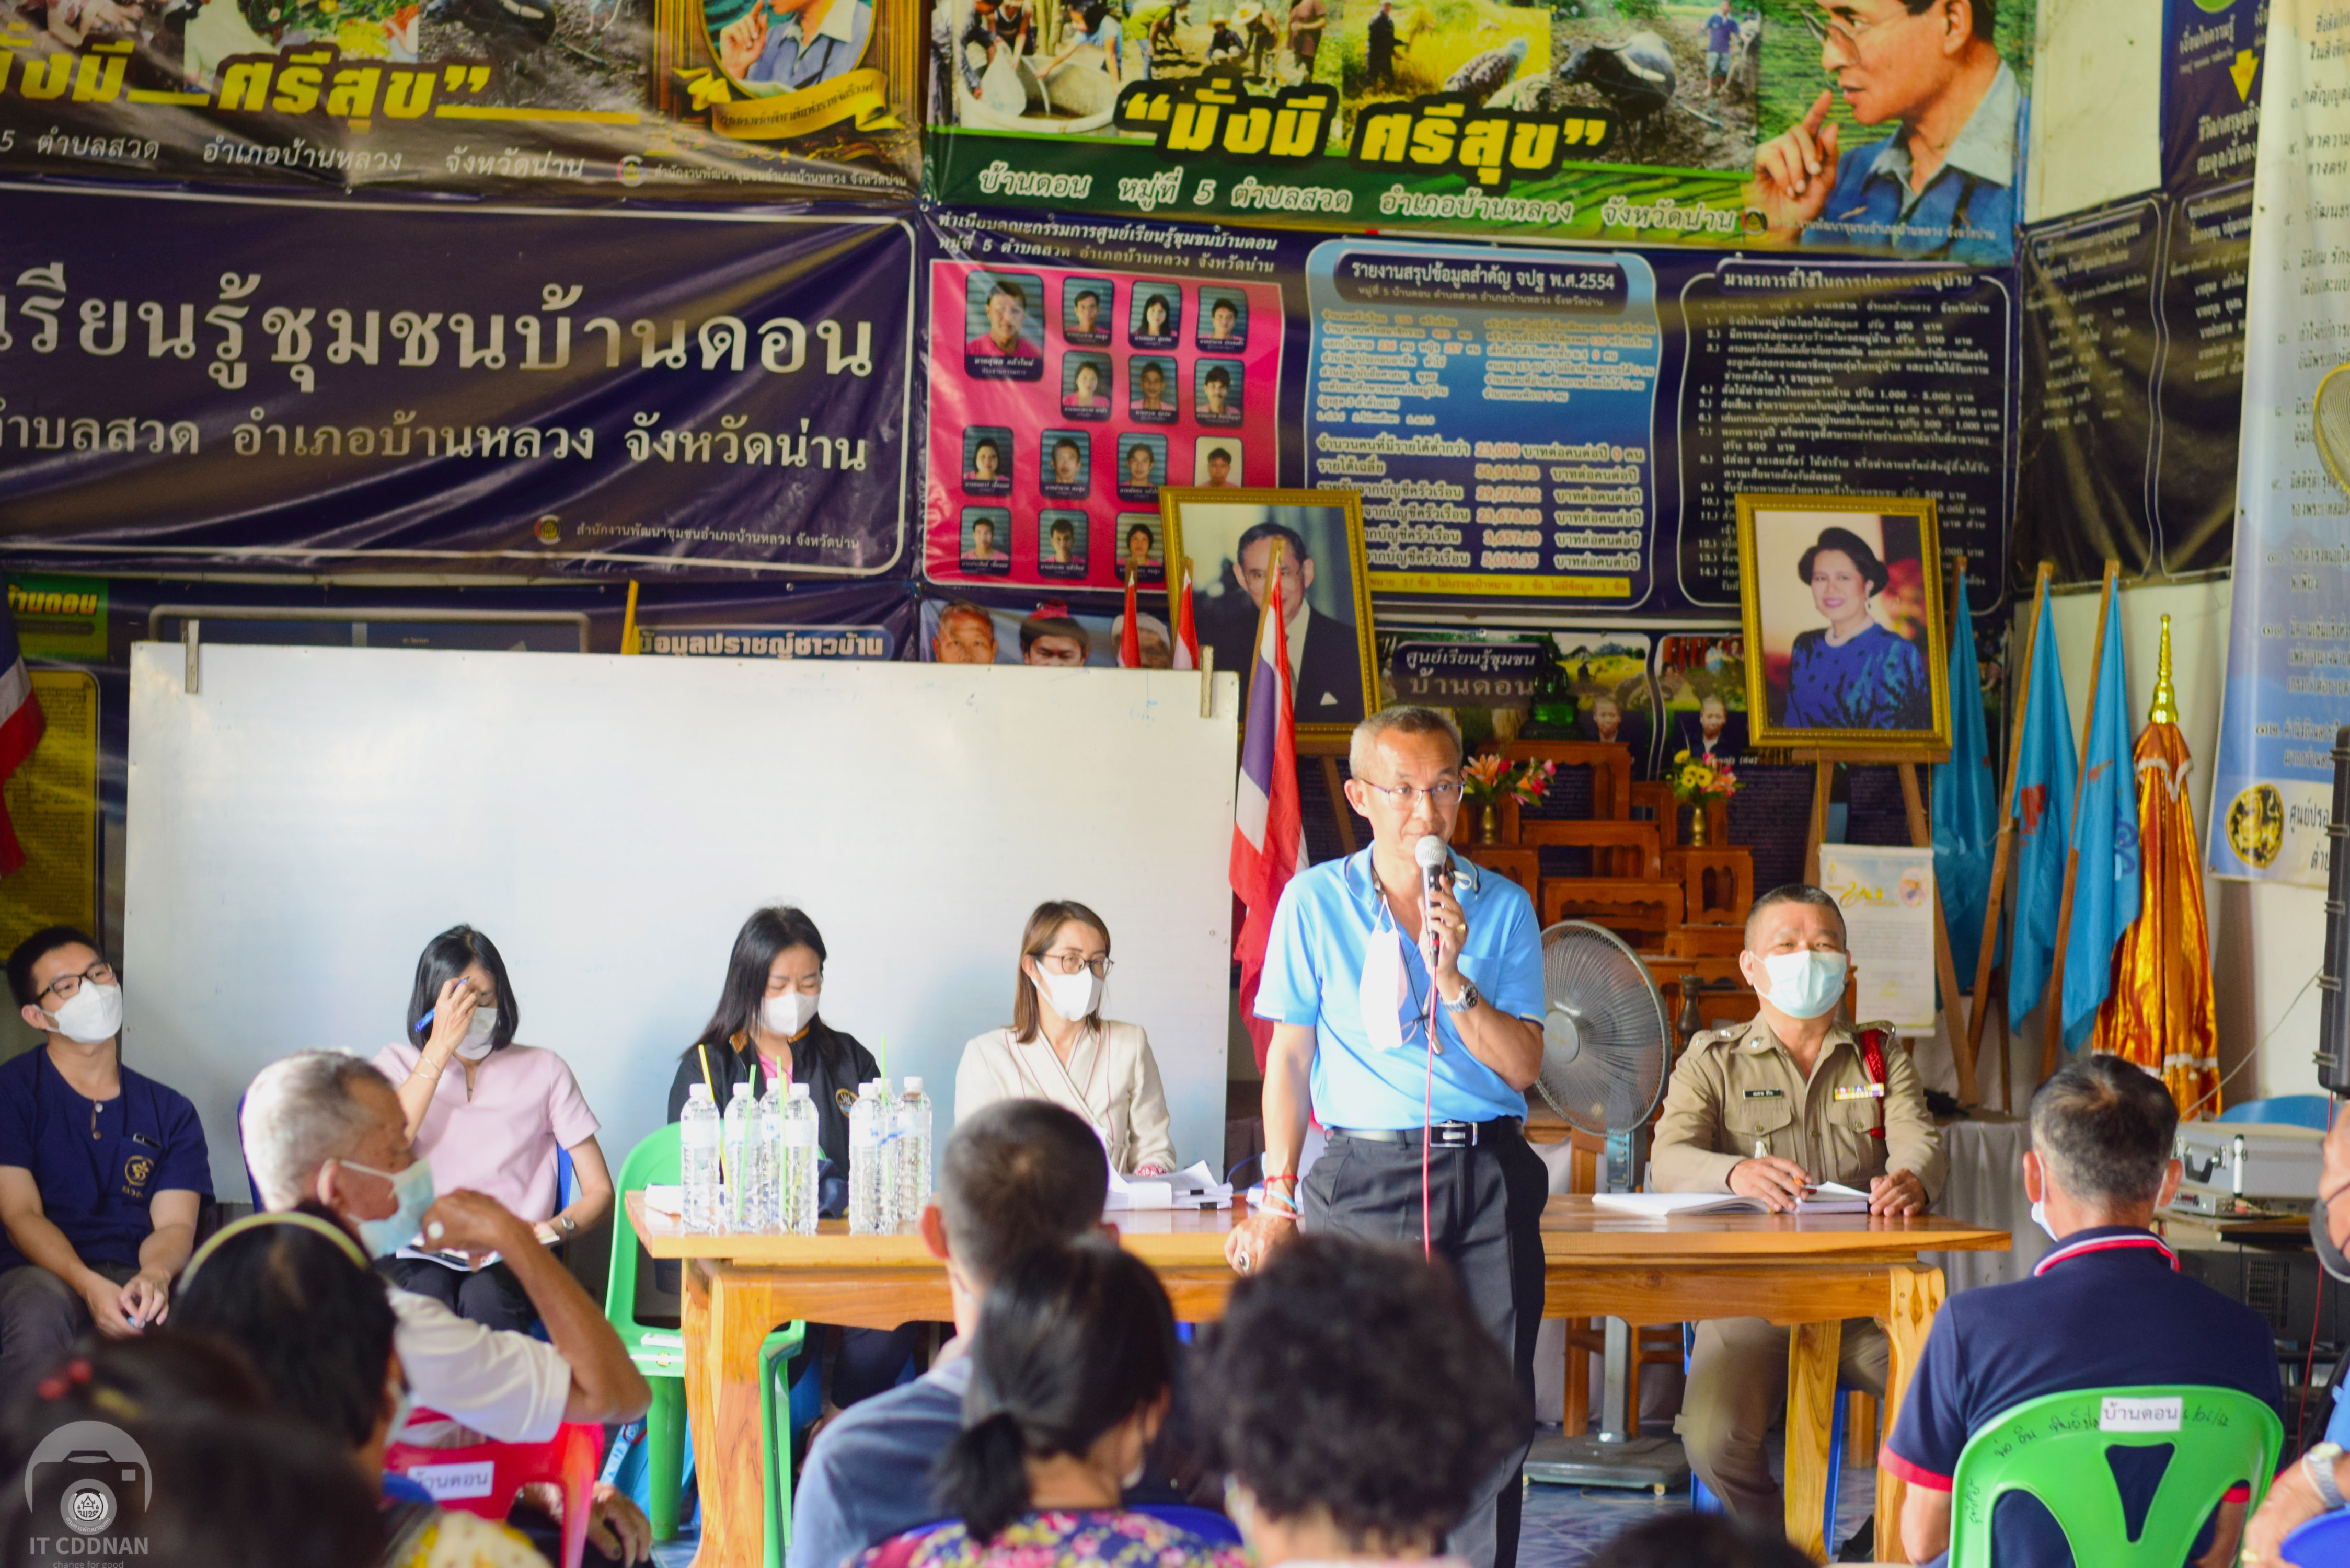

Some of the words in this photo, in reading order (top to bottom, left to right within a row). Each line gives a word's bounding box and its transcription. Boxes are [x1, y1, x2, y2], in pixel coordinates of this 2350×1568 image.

[0, 22, 134, 103] ั่งมี
[0, 131, 15, 152] 5
[38, 127, 159, 160] ตำบลสวด
[203, 136, 403, 171] อำเภอบ้านหลวง
[446, 145, 585, 177] จังหวัดน่าน
[978, 160, 1092, 199] บ้านดอน
[1118, 166, 1184, 211] หมู่ที่
[1194, 179, 1216, 205] 5
[1232, 176, 1352, 213] ตำบลสวด
[1379, 183, 1574, 224] อำเภอบ้านหลวง
[1602, 195, 1736, 233] จังหวัดน่าน
[938, 211, 1277, 253] ทำเนียบคณะกรรมการศูนย์เรียนรู้ชุมชนบ้านดอน
[939, 235, 973, 256] หมู่ที่
[983, 240, 992, 252] 5
[1000, 238, 1071, 258] ตำบลสวด
[1079, 244, 1190, 269] อำเภอบ้านหลวง
[1197, 251, 1275, 273] จังหวัดน่าน
[1352, 260, 1512, 292] รายงานสรุปข้อมูลสำคัญ
[1549, 268, 1615, 291] พ.ศ.2554
[1400, 341, 1415, 352] คน
[1466, 344, 1481, 355] คน
[0, 397, 199, 454] ำบลสวด
[233, 406, 595, 460] อำเภอบ้านหลวง
[625, 411, 867, 471] จังหวัดน่าน
[1316, 431, 1471, 457] จำนวนคนที่มีรายได้ต่ำกว่า
[1474, 441, 1520, 460] 23,000
[1521, 441, 1610, 463] บาทต่อคนต่อปี
[1623, 447, 1645, 463] คน
[1316, 454, 1386, 477] รายได้เฉลี่ย
[1550, 464, 1640, 485] บาทต่อคนต่อปี
[1553, 486, 1643, 506] บาทต่อคนต่อปี
[1554, 508, 1644, 528] บาทต่อคนต่อปี
[577, 522, 791, 547] สำนักงานพัฒนาชุมชนอำเภอบ้านหลวง
[796, 529, 859, 551] จังหวัดน่าน
[1554, 529, 1642, 549] บาทต่อคนต่อปี
[1553, 551, 1641, 571] บาทต่อคนต่อปี
[1406, 647, 1536, 672] ศูนย์เรียนรู้ชุมชน
[1411, 667, 1534, 697] บ้านดอน
[2289, 797, 2329, 834] ศูนย์ปรอ
[2103, 1401, 2179, 1422] บ้านดอน
